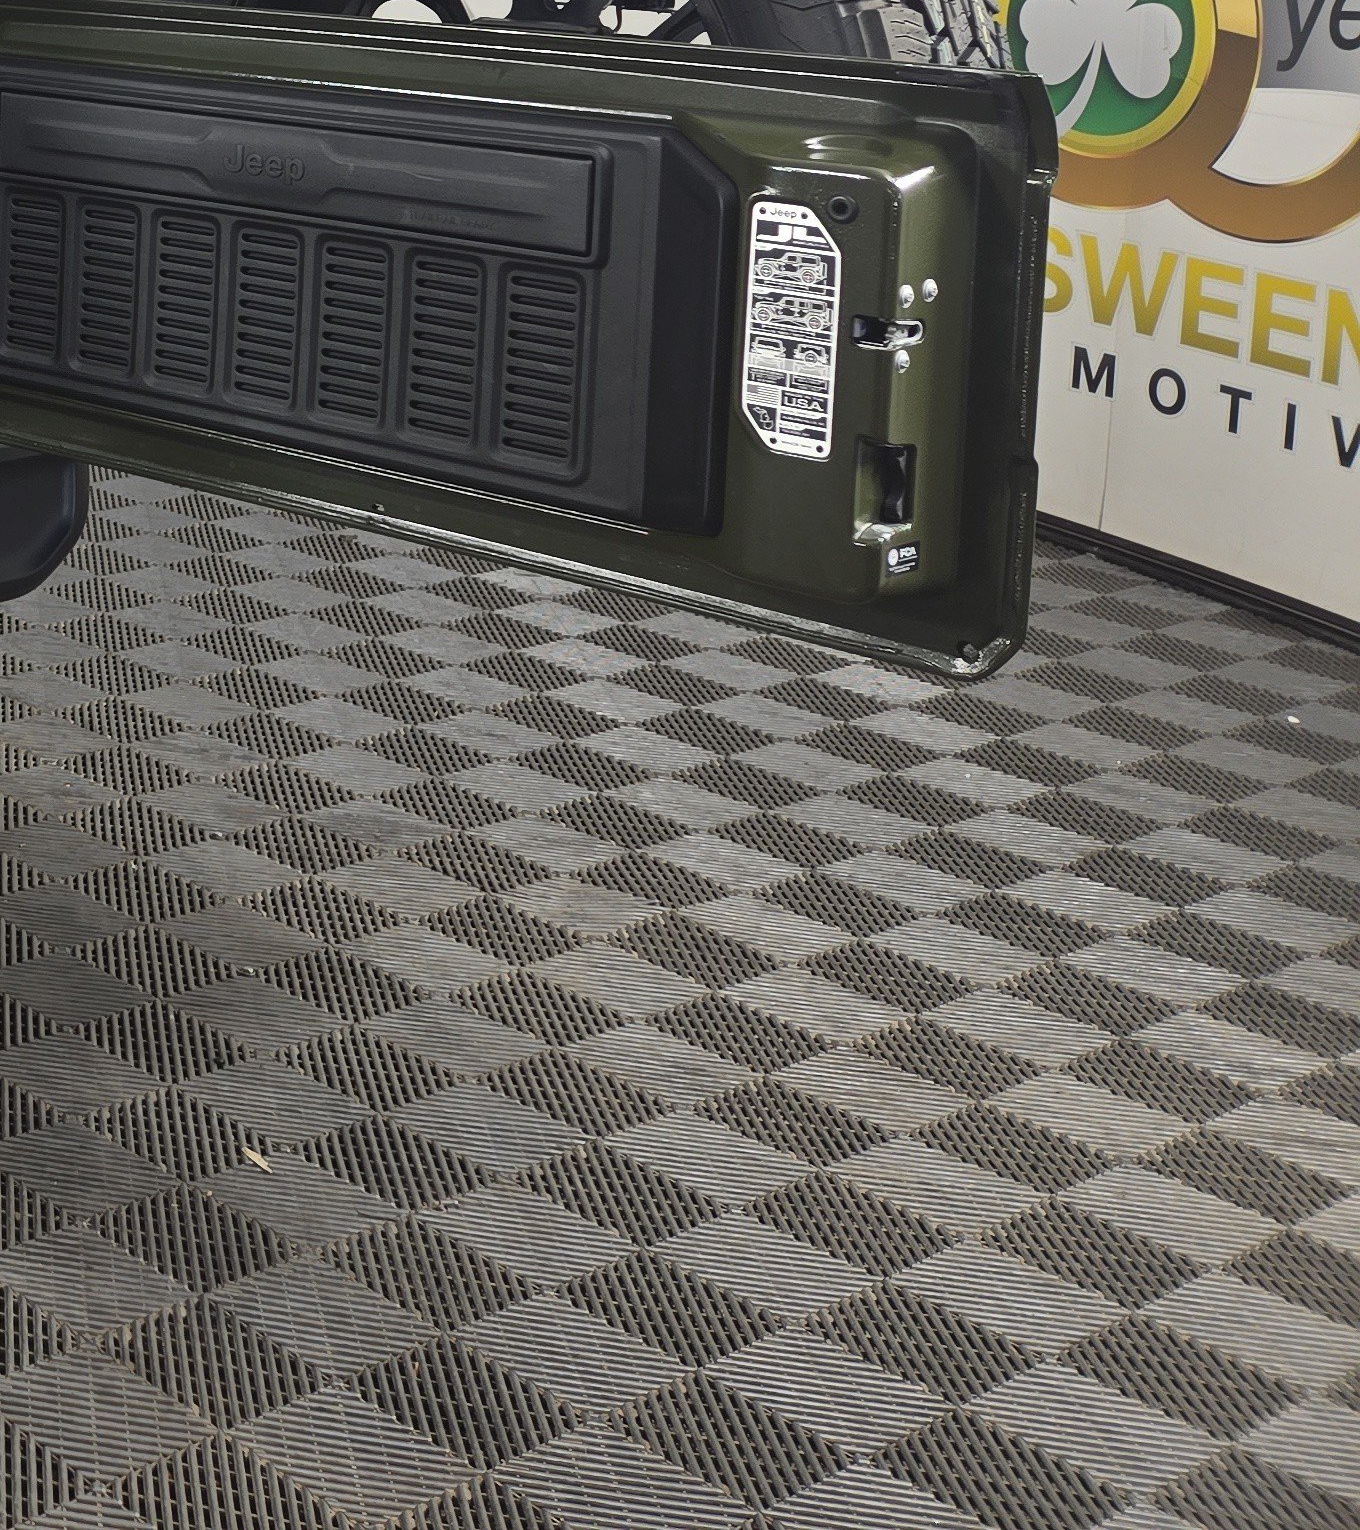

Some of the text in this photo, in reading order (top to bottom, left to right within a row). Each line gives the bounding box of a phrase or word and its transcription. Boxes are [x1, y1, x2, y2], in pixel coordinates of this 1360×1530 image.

[224, 143, 306, 182] Jeep
[769, 207, 798, 219] Jeep
[783, 395, 824, 412] USA
